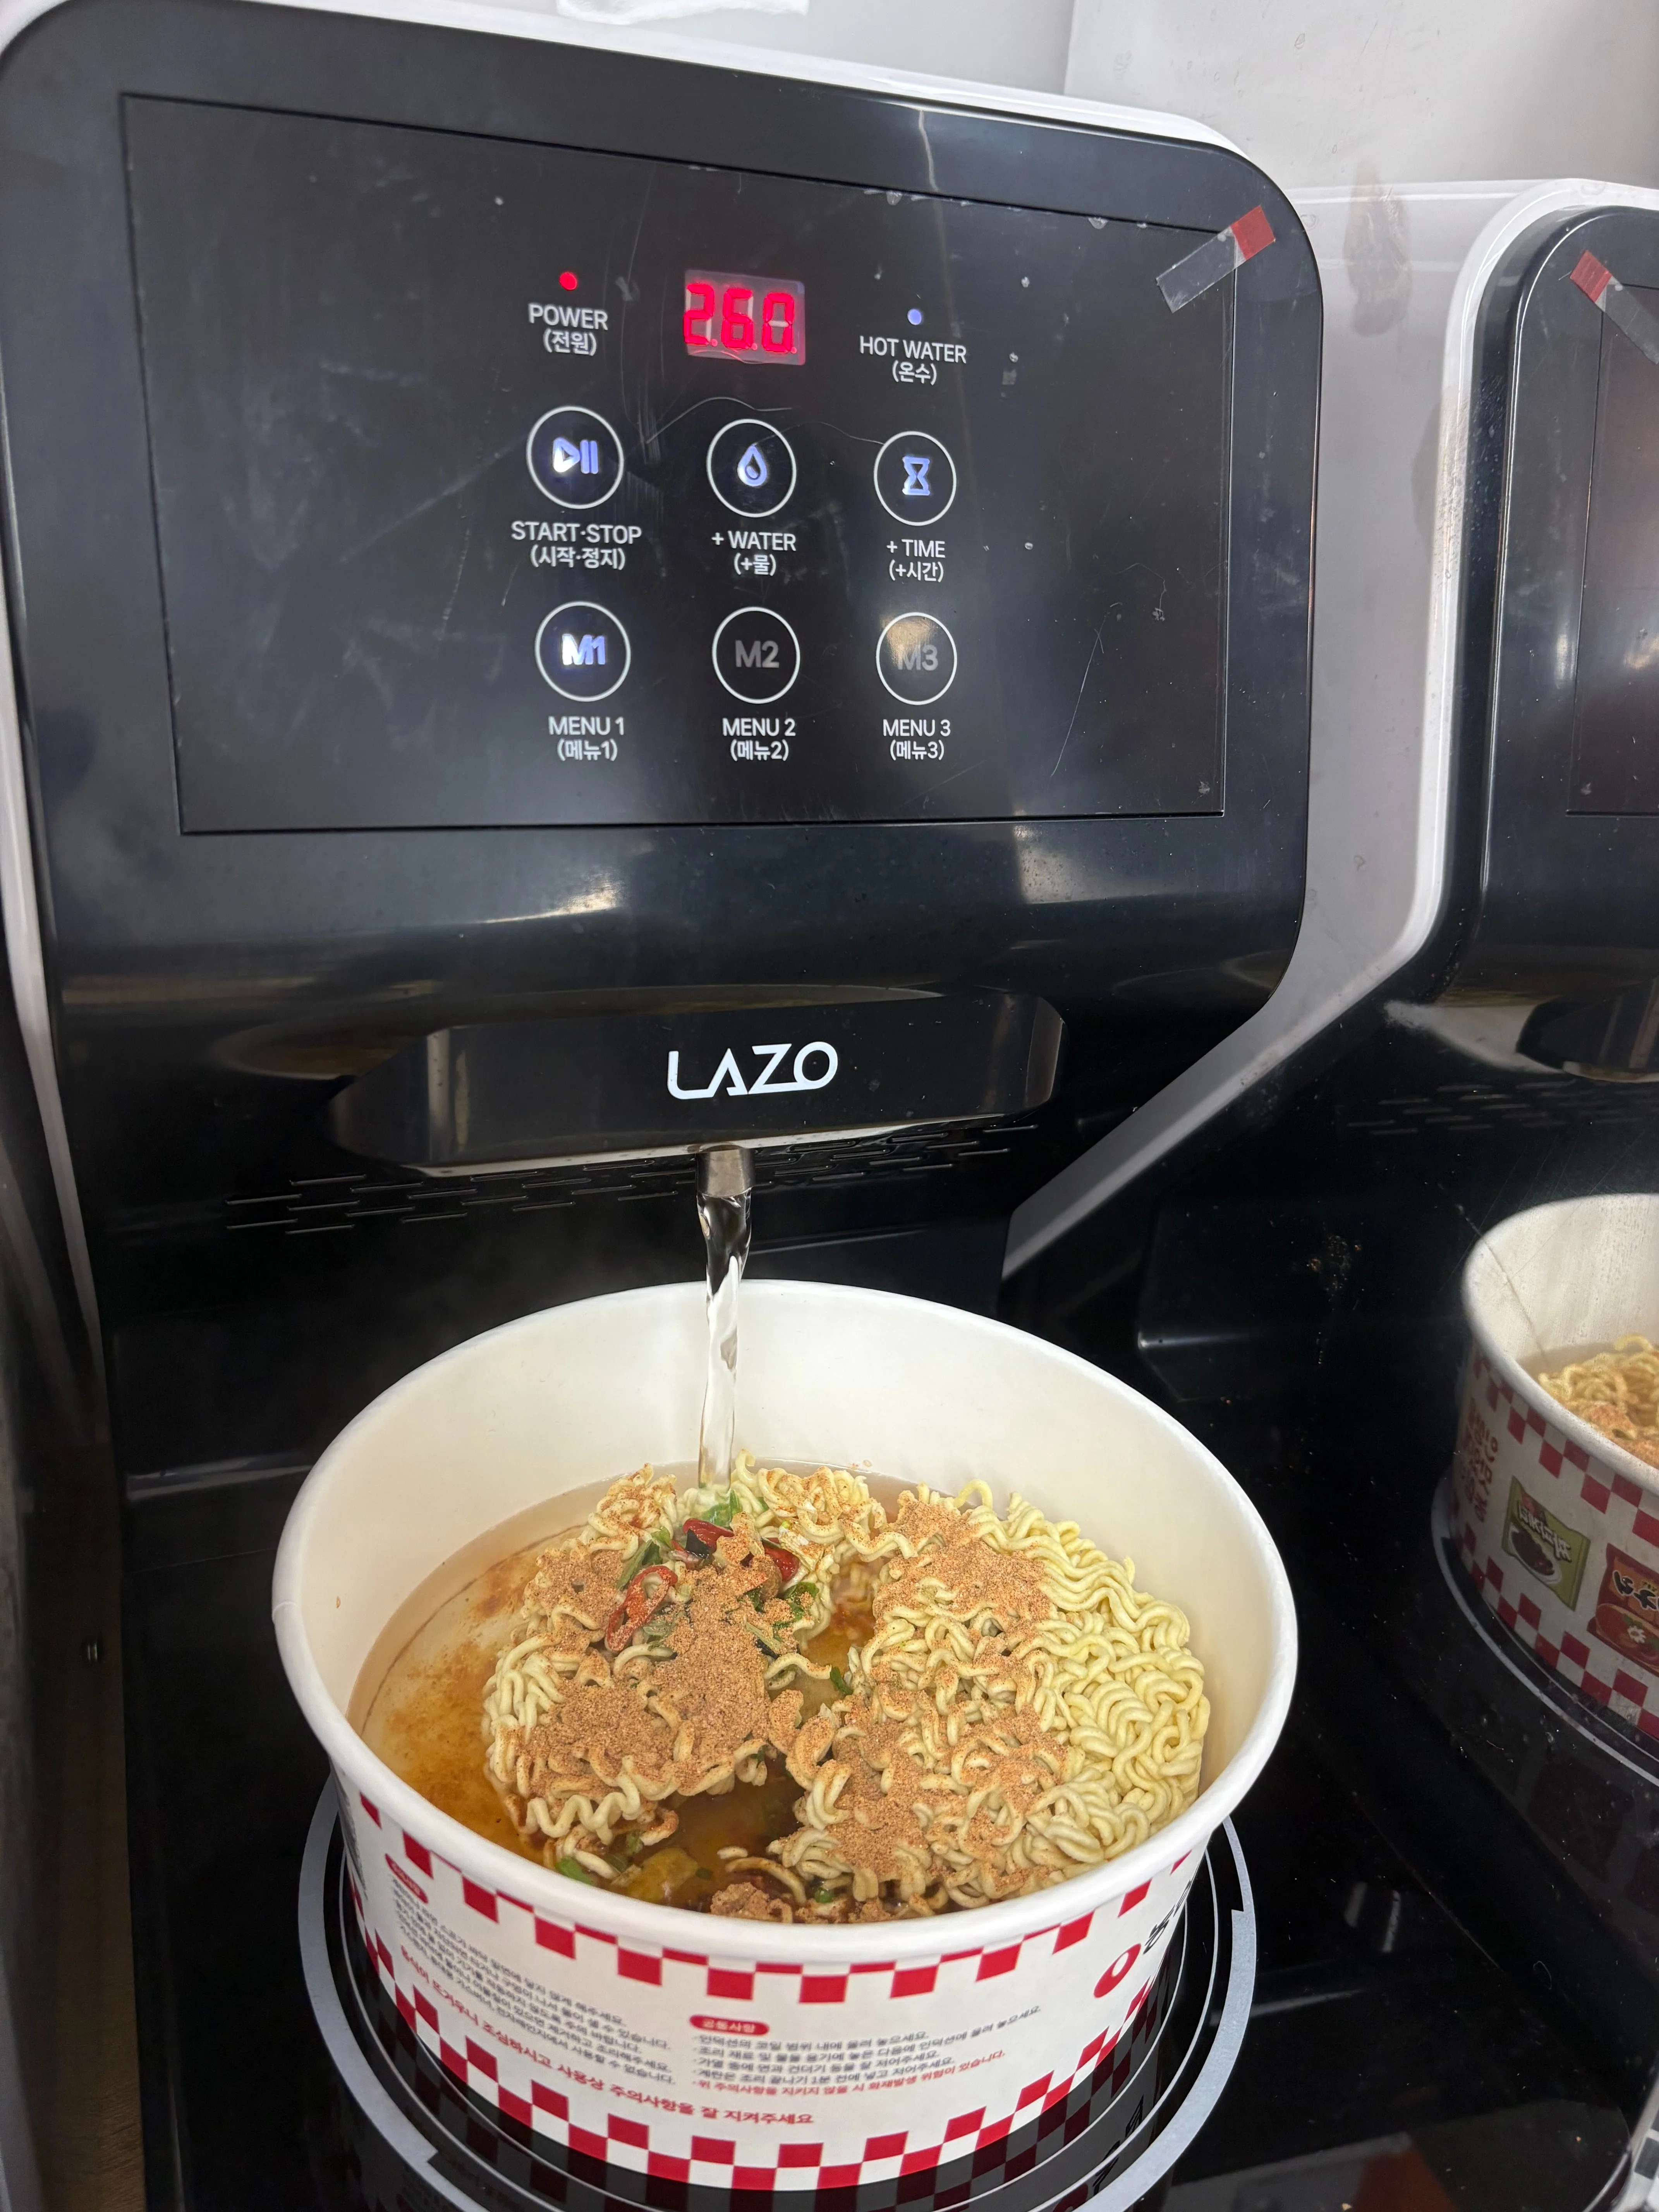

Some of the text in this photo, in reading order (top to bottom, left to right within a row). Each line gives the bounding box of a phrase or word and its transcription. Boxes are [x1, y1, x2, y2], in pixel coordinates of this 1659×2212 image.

[529, 304, 608, 330] POWER
[683, 282, 797, 354] 260
[544, 331, 596, 356] (전원)
[860, 336, 966, 365] HOT WATER
[893, 361, 937, 385] (온수)
[728, 531, 796, 551] WATER
[902, 539, 945, 558] TIME
[734, 553, 776, 576] (+물)
[890, 560, 943, 582] (+시간)
[562, 634, 605, 665] M1
[736, 641, 779, 668] M2
[897, 644, 938, 671] M3
[549, 716, 623, 735] MENU 1
[723, 718, 795, 736] MENU 2
[883, 720, 950, 736] MENU 3
[558, 739, 617, 761] (메뉴1)
[731, 739, 788, 761] (메뉴2)
[890, 740, 944, 760] (메뉴3)
[668, 1042, 838, 1099] LAZO
[483, 2023, 551, 2068] 조심하시고
[558, 2063, 604, 2091] 사용상
[610, 2084, 695, 2116] 주의사항을
[701, 2106, 719, 2119] 잘
[723, 2109, 814, 2124] 지켜주세요
